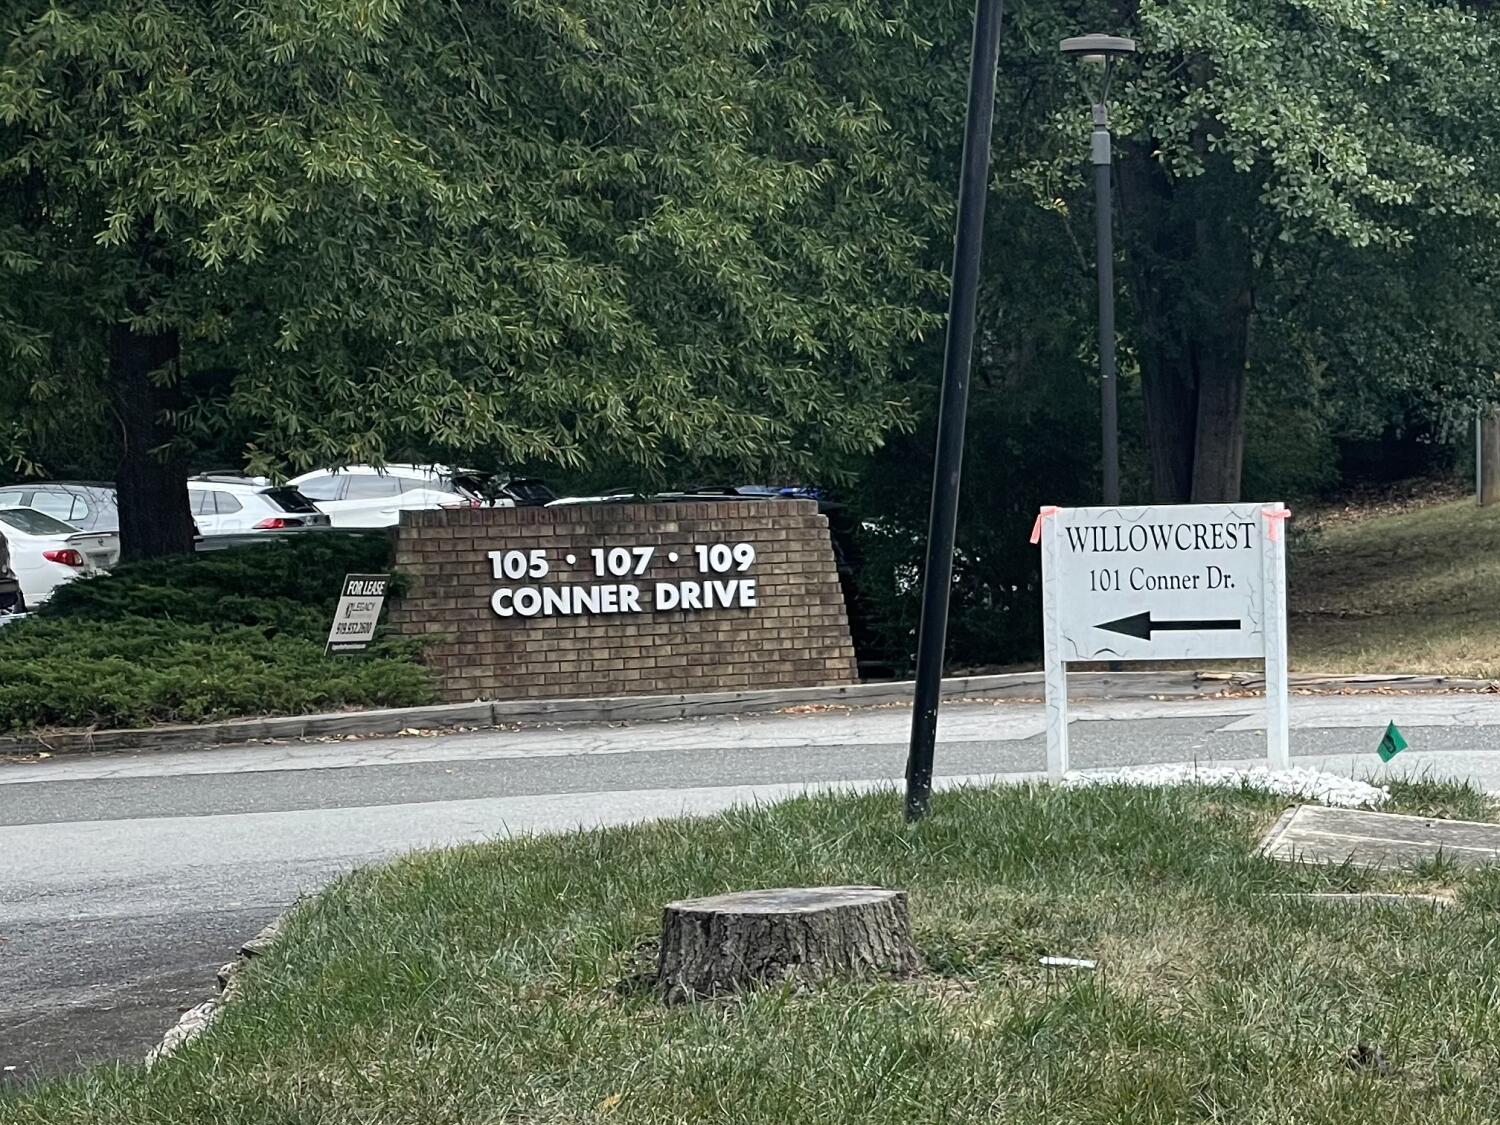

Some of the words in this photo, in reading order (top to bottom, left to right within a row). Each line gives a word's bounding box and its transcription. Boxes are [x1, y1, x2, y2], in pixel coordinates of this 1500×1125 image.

[1065, 522, 1256, 552] WILLOWCREST
[487, 549, 549, 579] 105
[590, 546, 655, 577] 107
[694, 543, 756, 573] 109
[346, 580, 363, 595] FOR
[363, 580, 386, 595] LEASE
[1090, 568, 1121, 591] 101
[1129, 567, 1200, 591] Conner
[1206, 565, 1236, 589] Dr.
[490, 584, 643, 617] CONNER
[655, 579, 757, 610] DRIVE
